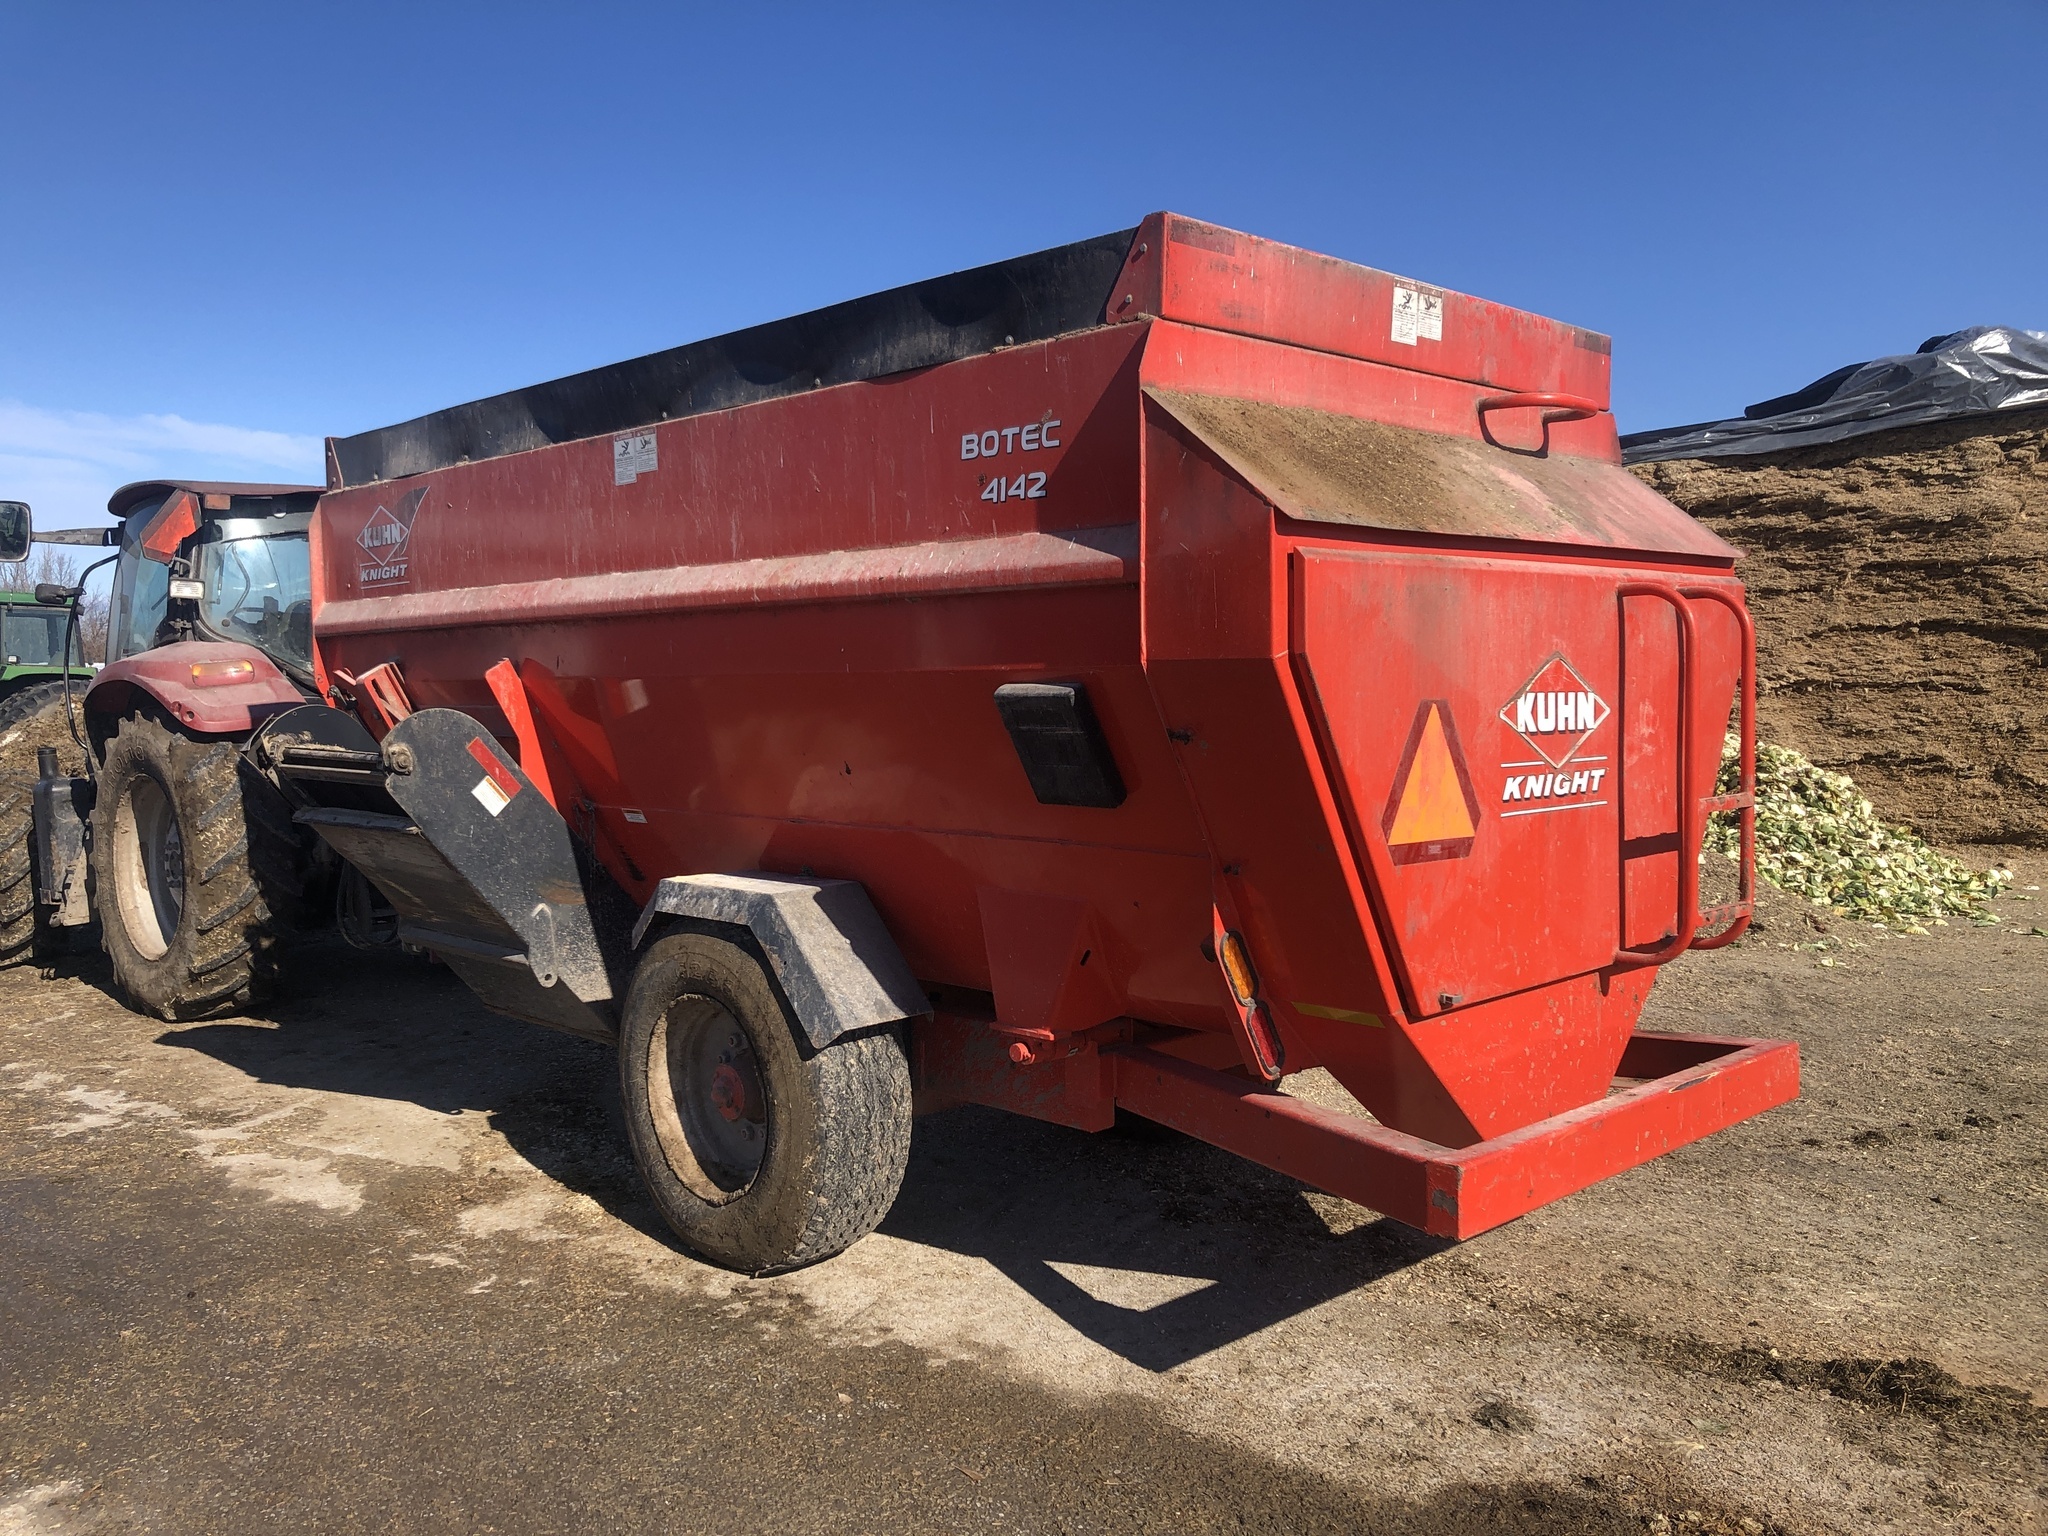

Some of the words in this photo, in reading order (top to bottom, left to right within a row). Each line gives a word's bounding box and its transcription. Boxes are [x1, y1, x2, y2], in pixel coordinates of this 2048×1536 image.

[961, 419, 1061, 460] BOTEC
[981, 471, 1047, 503] 4142
[364, 522, 401, 548] KUHN
[361, 564, 408, 582] KNIGHT
[1516, 691, 1596, 734] KUHN
[1502, 768, 1606, 802] KNIGHT
